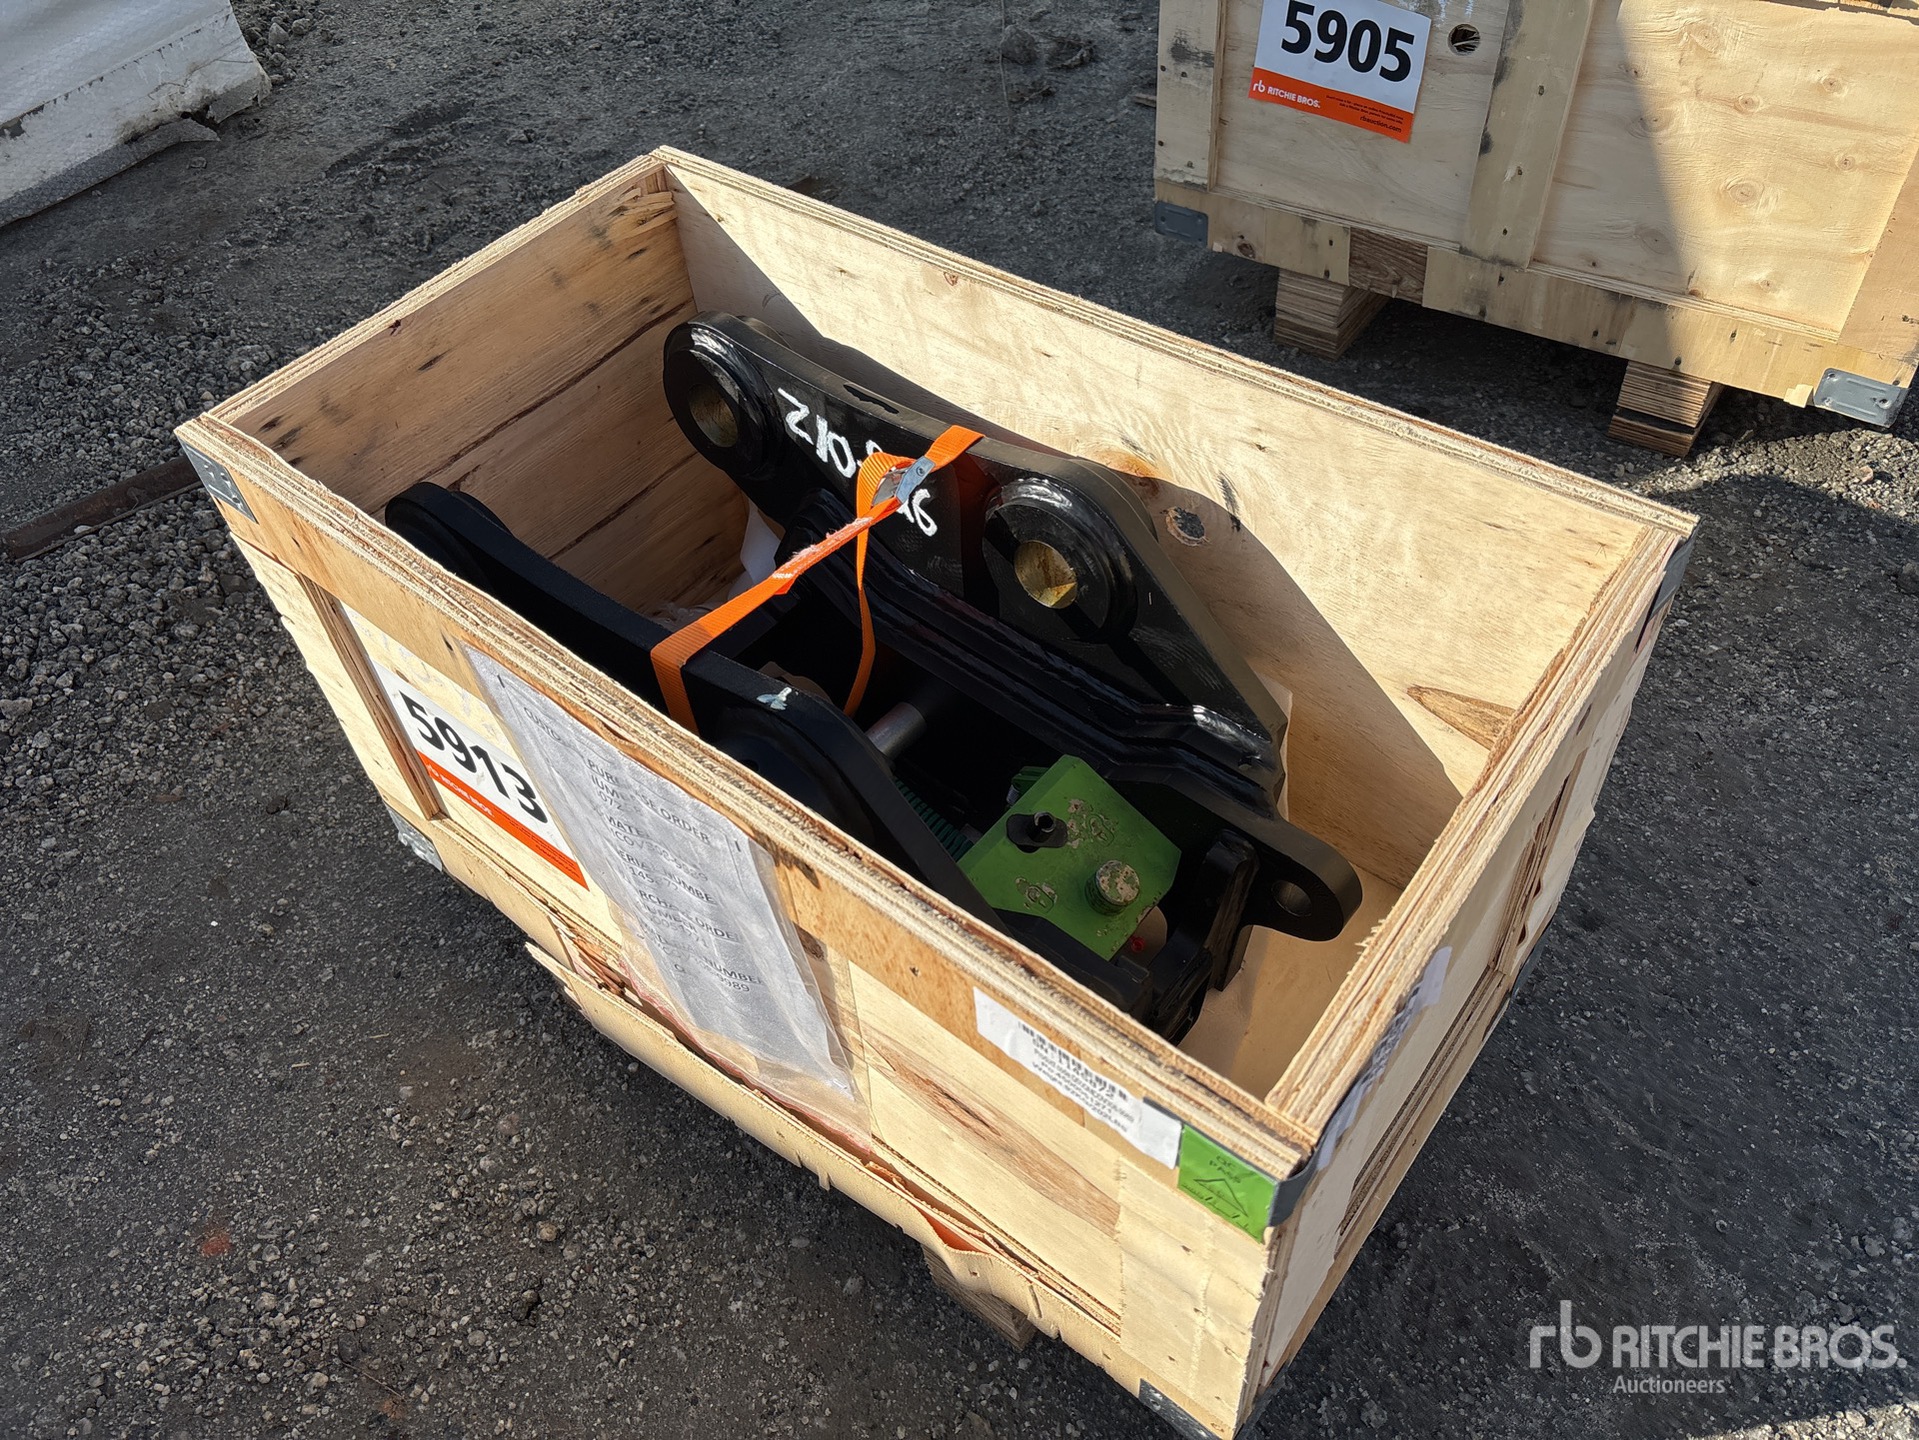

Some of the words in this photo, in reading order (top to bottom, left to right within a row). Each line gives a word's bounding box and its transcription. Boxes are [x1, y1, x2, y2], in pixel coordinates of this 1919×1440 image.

[1281, 0, 1414, 82] 5905
[1267, 86, 1297, 102] RITCHIE
[398, 690, 548, 824] 5913
[659, 807, 712, 846] ORDER
